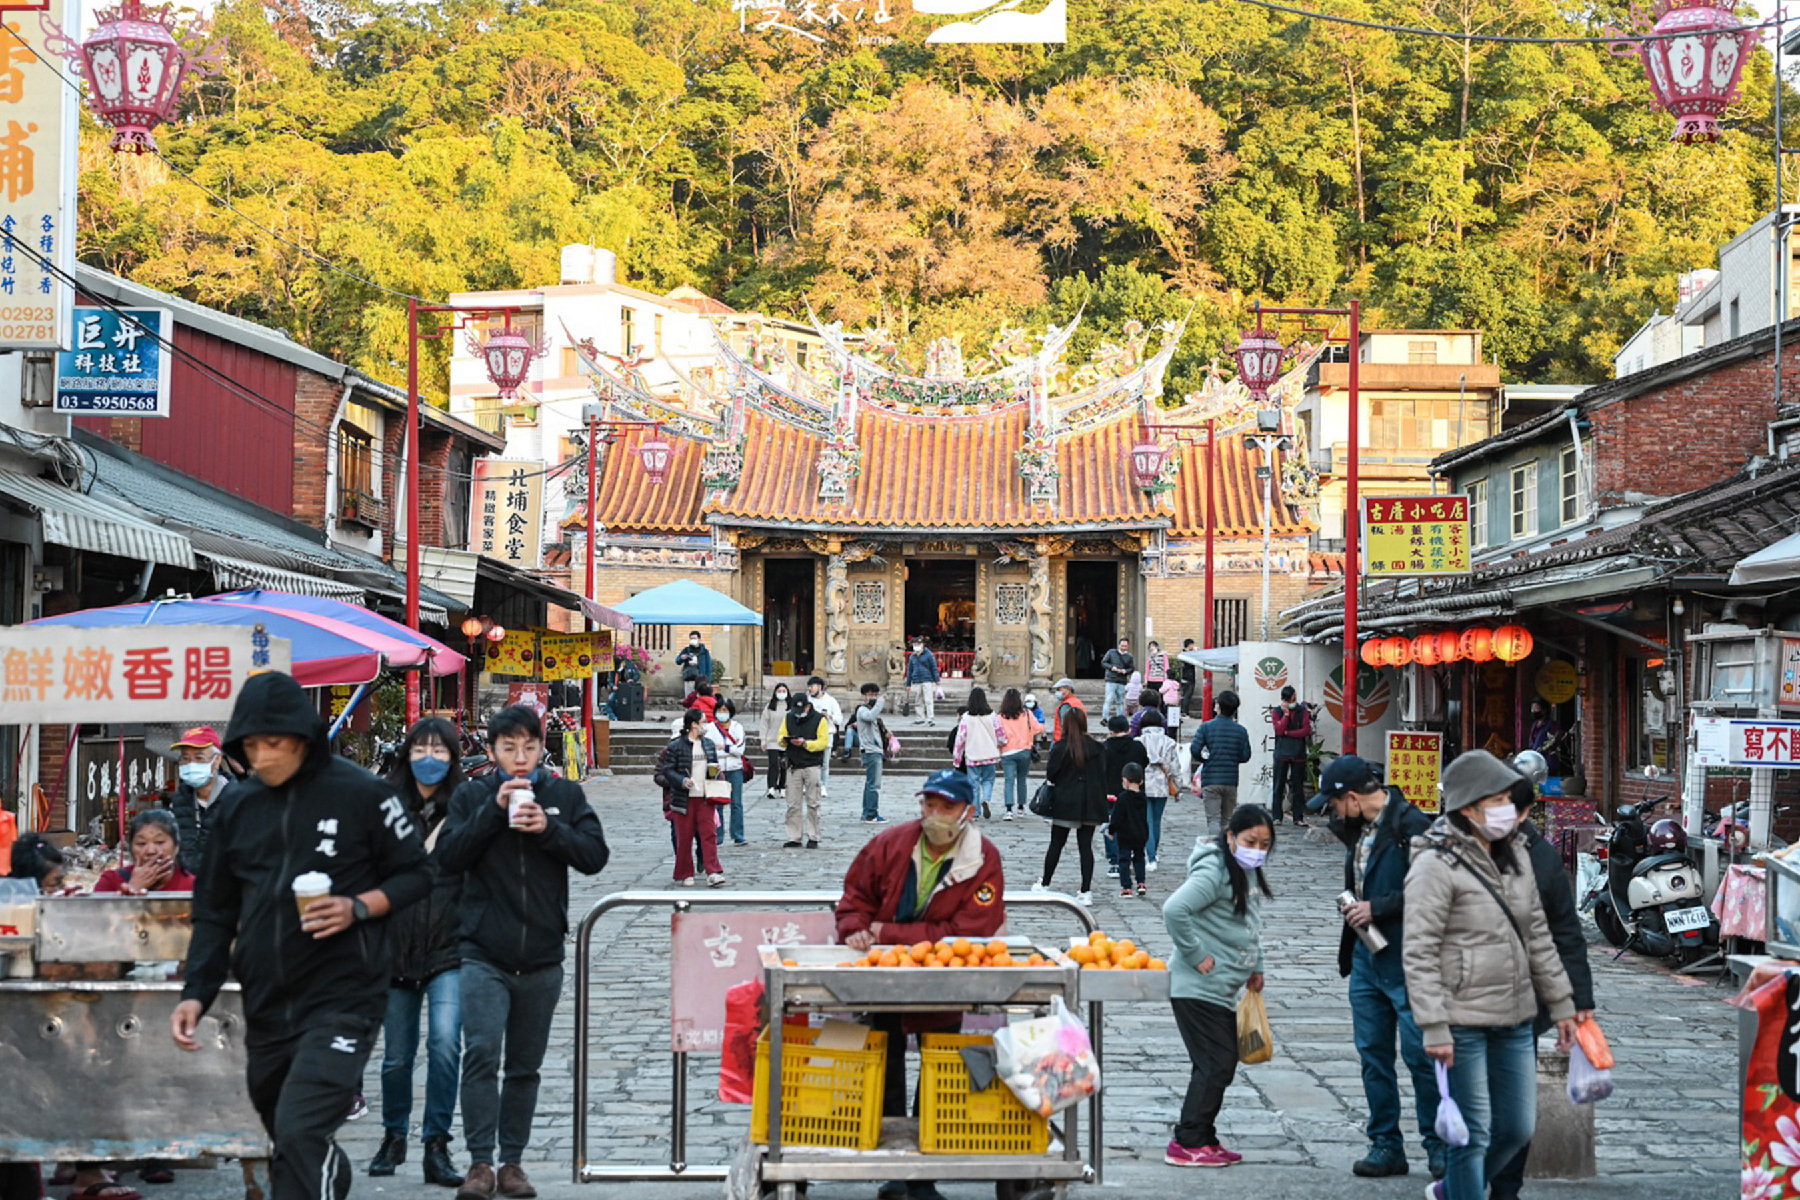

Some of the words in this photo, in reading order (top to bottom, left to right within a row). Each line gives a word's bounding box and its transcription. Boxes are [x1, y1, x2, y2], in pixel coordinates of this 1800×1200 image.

[0, 307, 54, 320] 02923
[0, 325, 54, 339] 02781
[75, 353, 143, 374] 科技社
[505, 468, 529, 560] 北埔食堂
[1370, 501, 1464, 521] 古厝小吃店
[1449, 524, 1465, 569] 客家小吃
[2, 645, 232, 701] 鮮嫩香腸
[1391, 736, 1438, 750] 古厝小吃
[1390, 768, 1436, 782] 客家小吃
[1402, 784, 1435, 798] 機蔬菜
